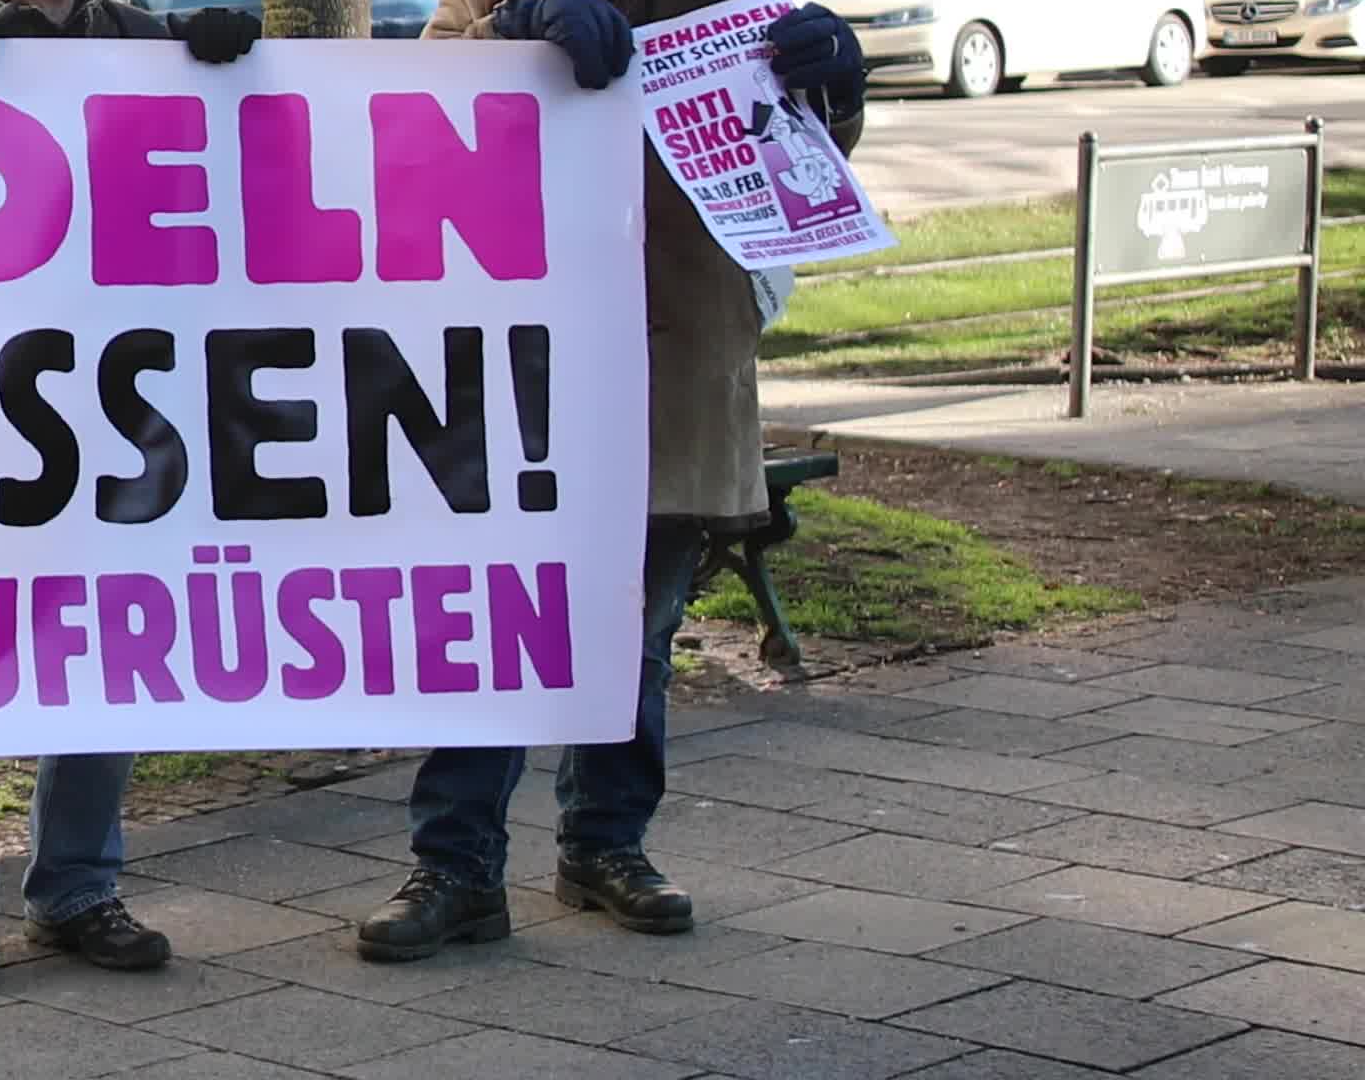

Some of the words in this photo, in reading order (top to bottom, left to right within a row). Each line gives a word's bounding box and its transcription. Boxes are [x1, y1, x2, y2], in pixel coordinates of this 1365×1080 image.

[640, 49, 688, 78] TATT
[689, 23, 771, 62] SCHIESS
[643, 1, 791, 57] ERHANDELN
[641, 64, 707, 96] ABRÜSTEN
[707, 52, 743, 74] STATT
[654, 86, 736, 134] ANTI
[663, 114, 747, 161] SIKO
[676, 142, 758, 182] DEMO
